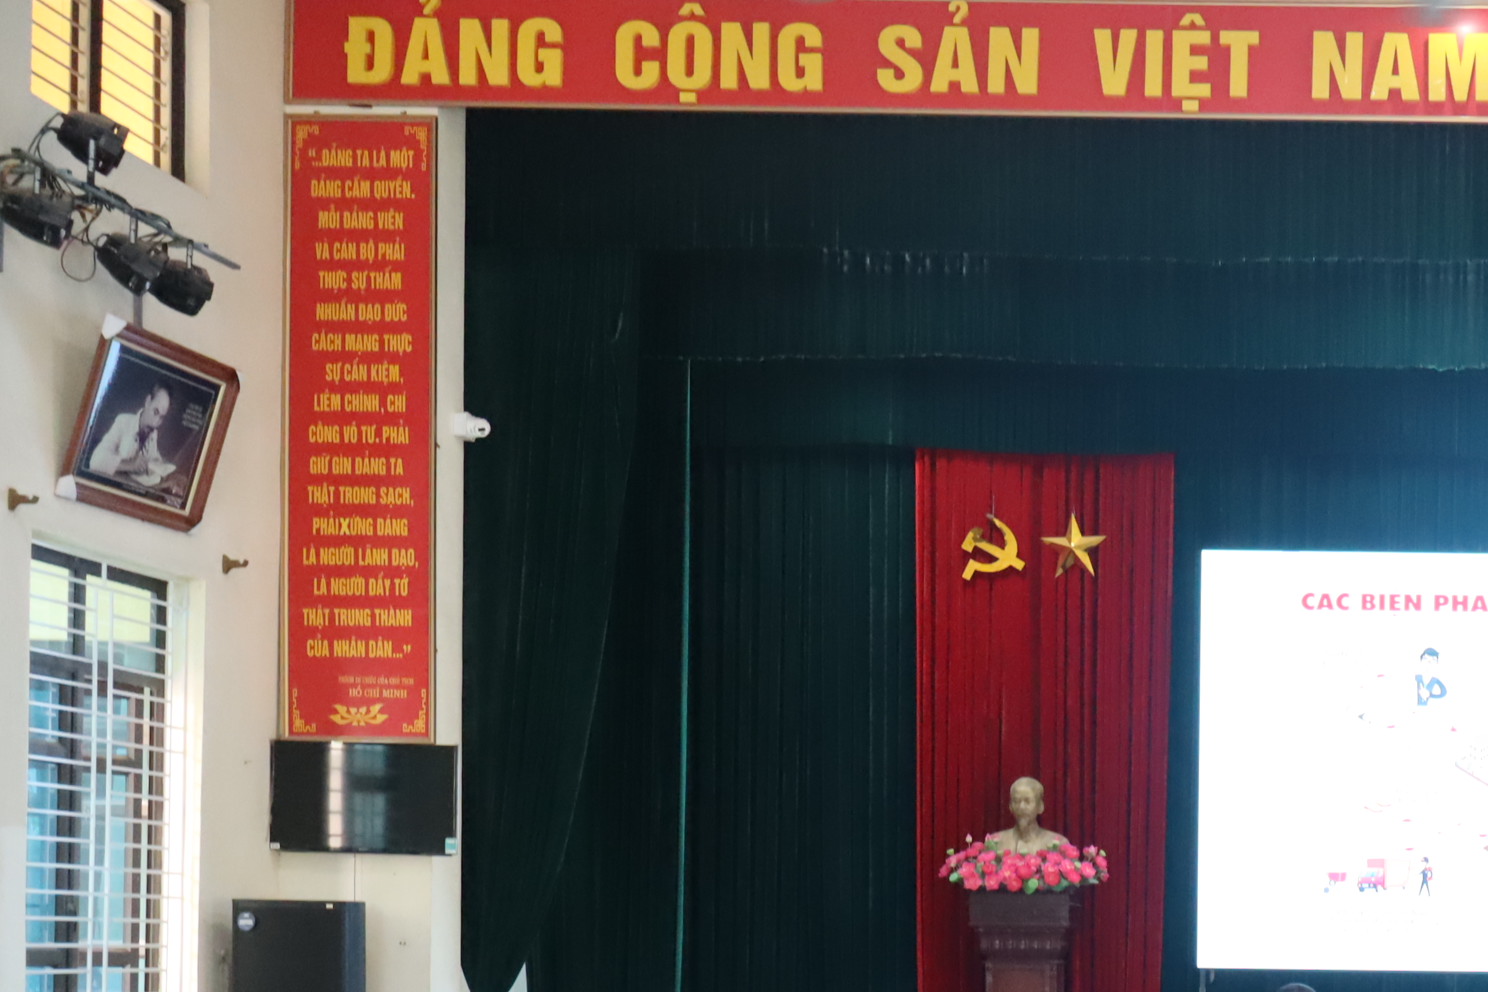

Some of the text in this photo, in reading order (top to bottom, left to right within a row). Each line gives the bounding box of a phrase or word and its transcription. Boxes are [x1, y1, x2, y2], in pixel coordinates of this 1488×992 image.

[345, 0, 562, 87] ĐẢNG
[616, 3, 822, 102] CỘNG
[878, 2, 1039, 95] SẢN
[1095, 14, 1259, 112] VIỆT
[356, 149, 370, 167] TA
[389, 458, 404, 476] TA
[339, 485, 376, 504] TRONG
[334, 608, 371, 626] TRUNG
[382, 688, 407, 699] MINH
